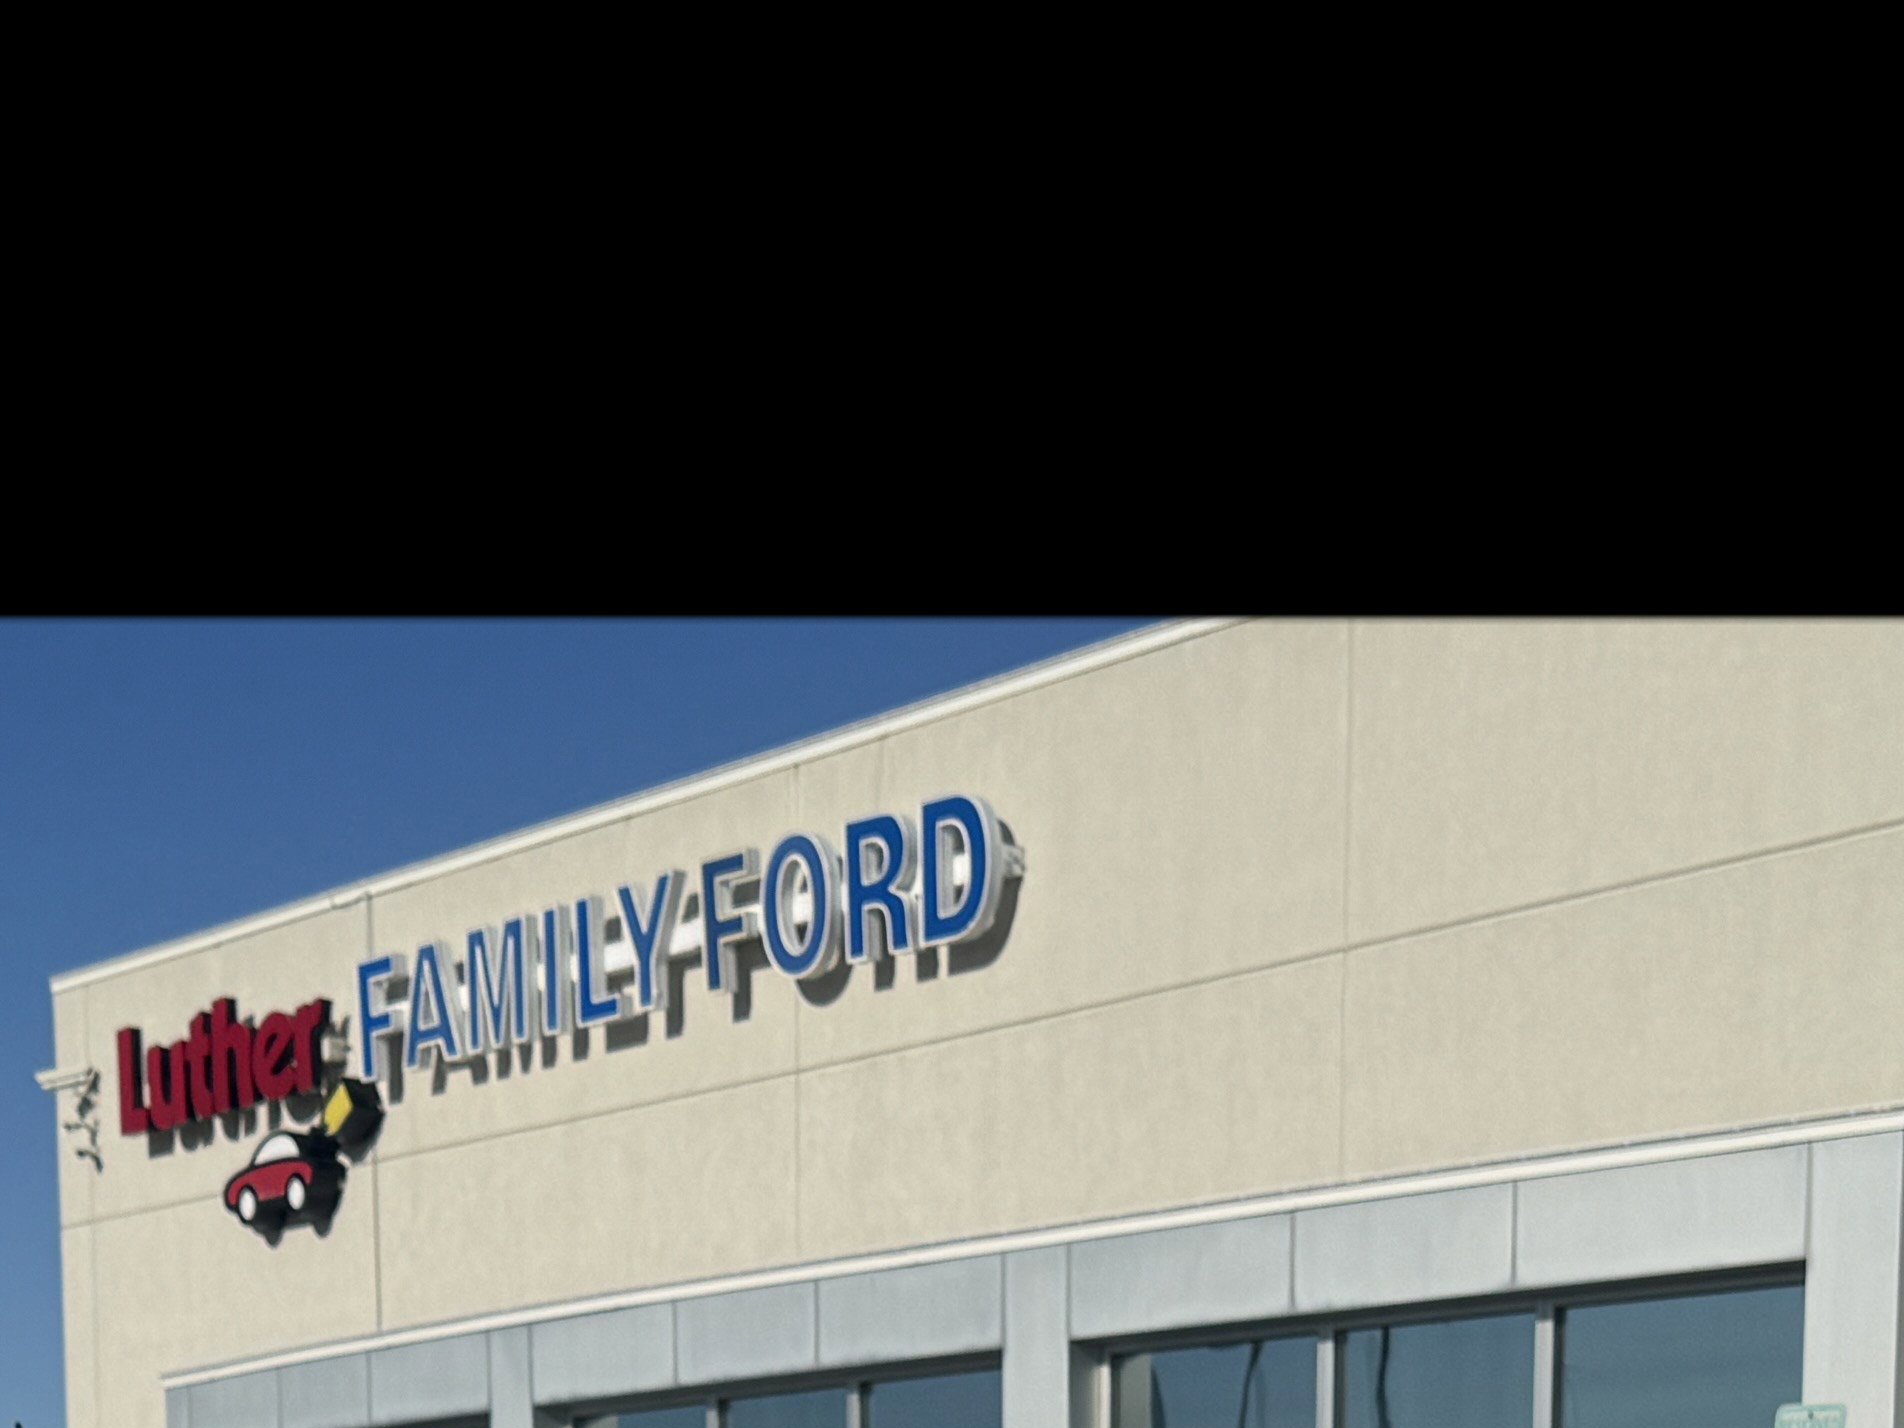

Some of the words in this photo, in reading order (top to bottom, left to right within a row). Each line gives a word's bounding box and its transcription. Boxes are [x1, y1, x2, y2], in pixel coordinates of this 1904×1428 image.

[356, 870, 680, 1083] FAMILY
[701, 794, 999, 992] FORD
[117, 997, 328, 1137] Luther
